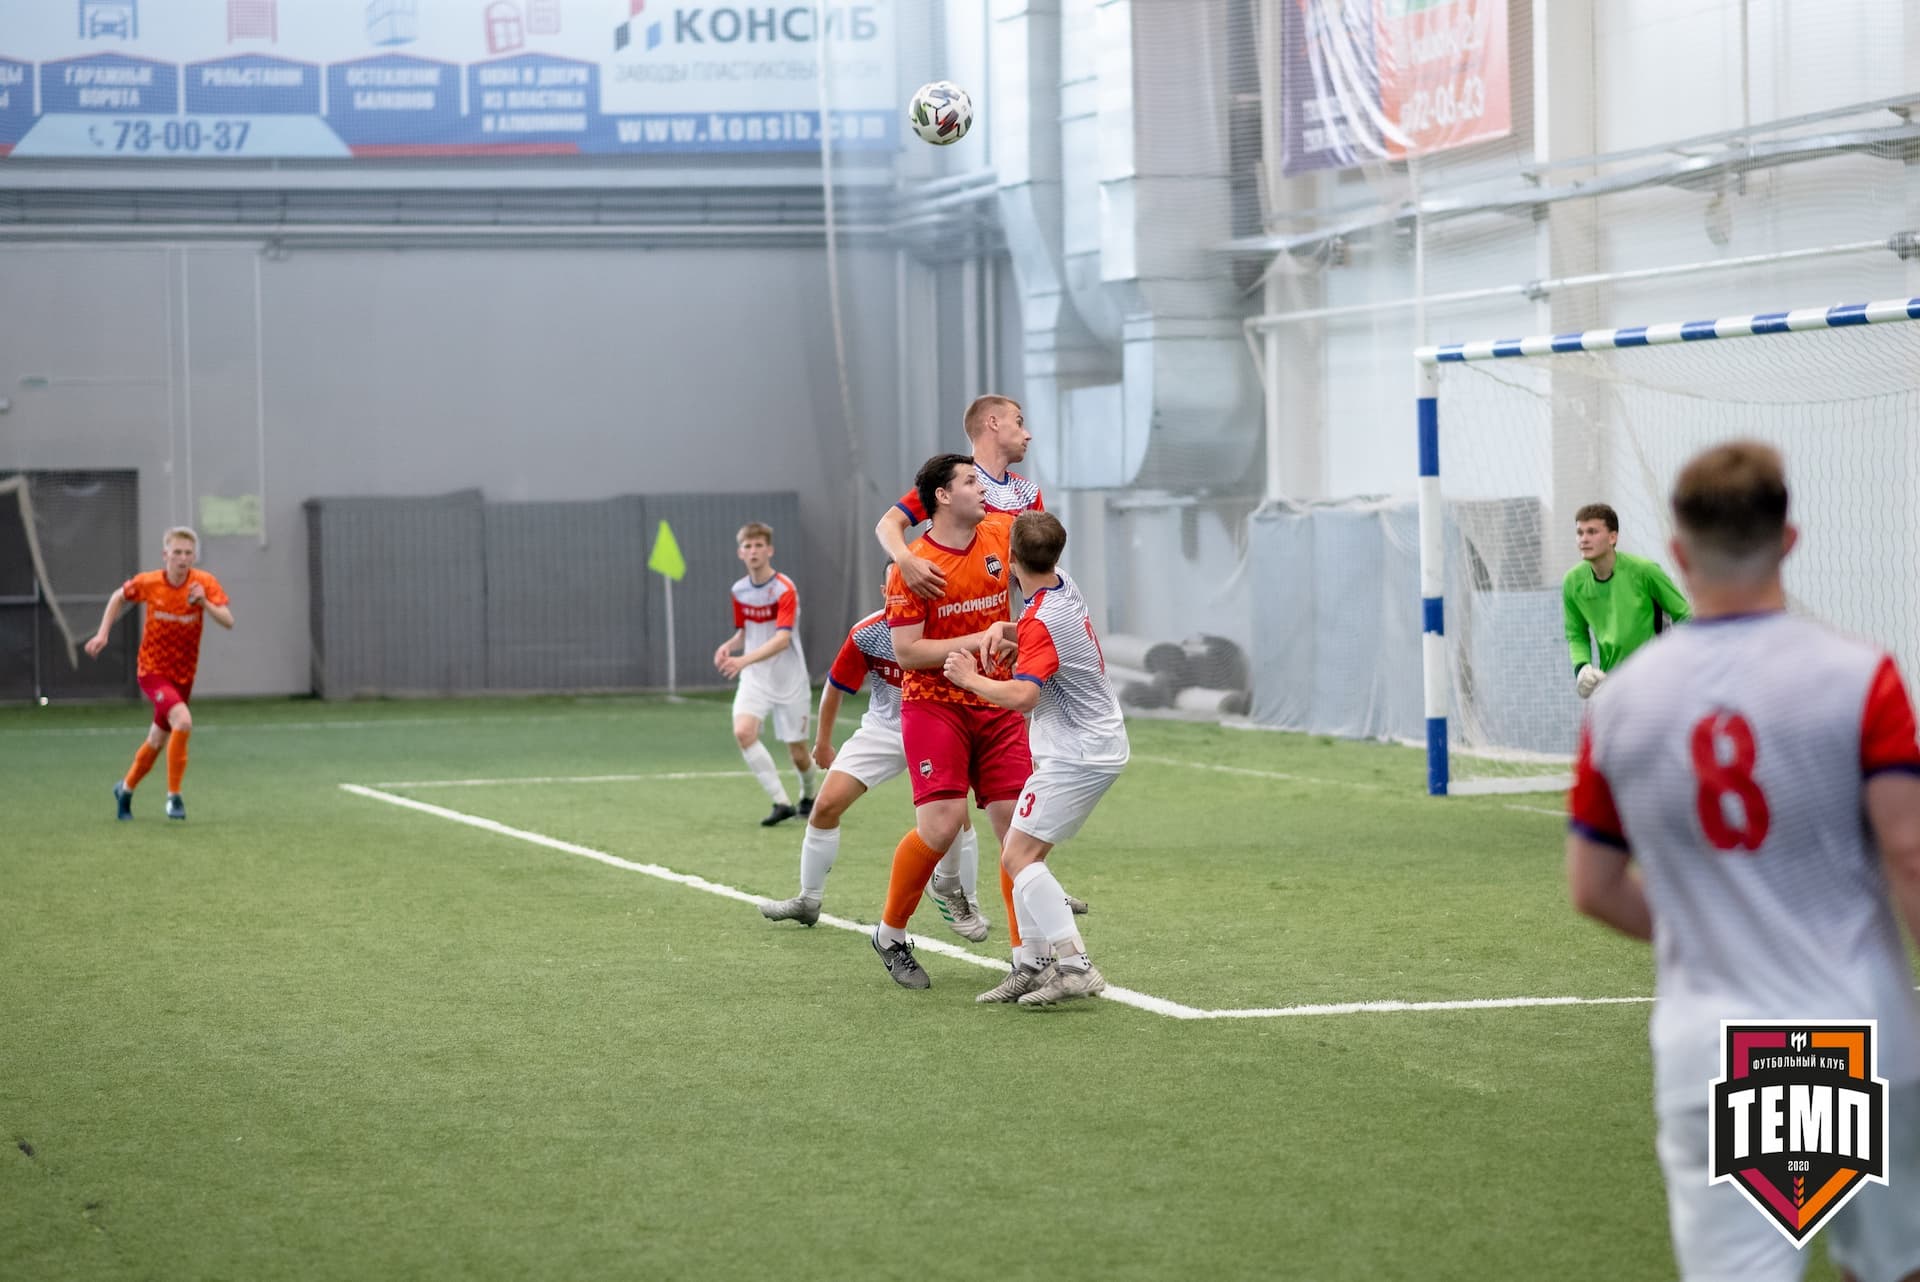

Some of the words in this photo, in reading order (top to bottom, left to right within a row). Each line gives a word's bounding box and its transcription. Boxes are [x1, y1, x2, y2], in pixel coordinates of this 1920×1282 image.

[674, 7, 877, 43] КОНСИБ
[693, 60, 829, 81] ПЛАСТИКОВЫ
[113, 119, 251, 151] 73-00-37
[617, 113, 886, 143] www.konsib.com
[937, 589, 1007, 619] ПРОДИНВЕСТ
[1691, 706, 1770, 852] 8
[1020, 792, 1036, 818] 3
